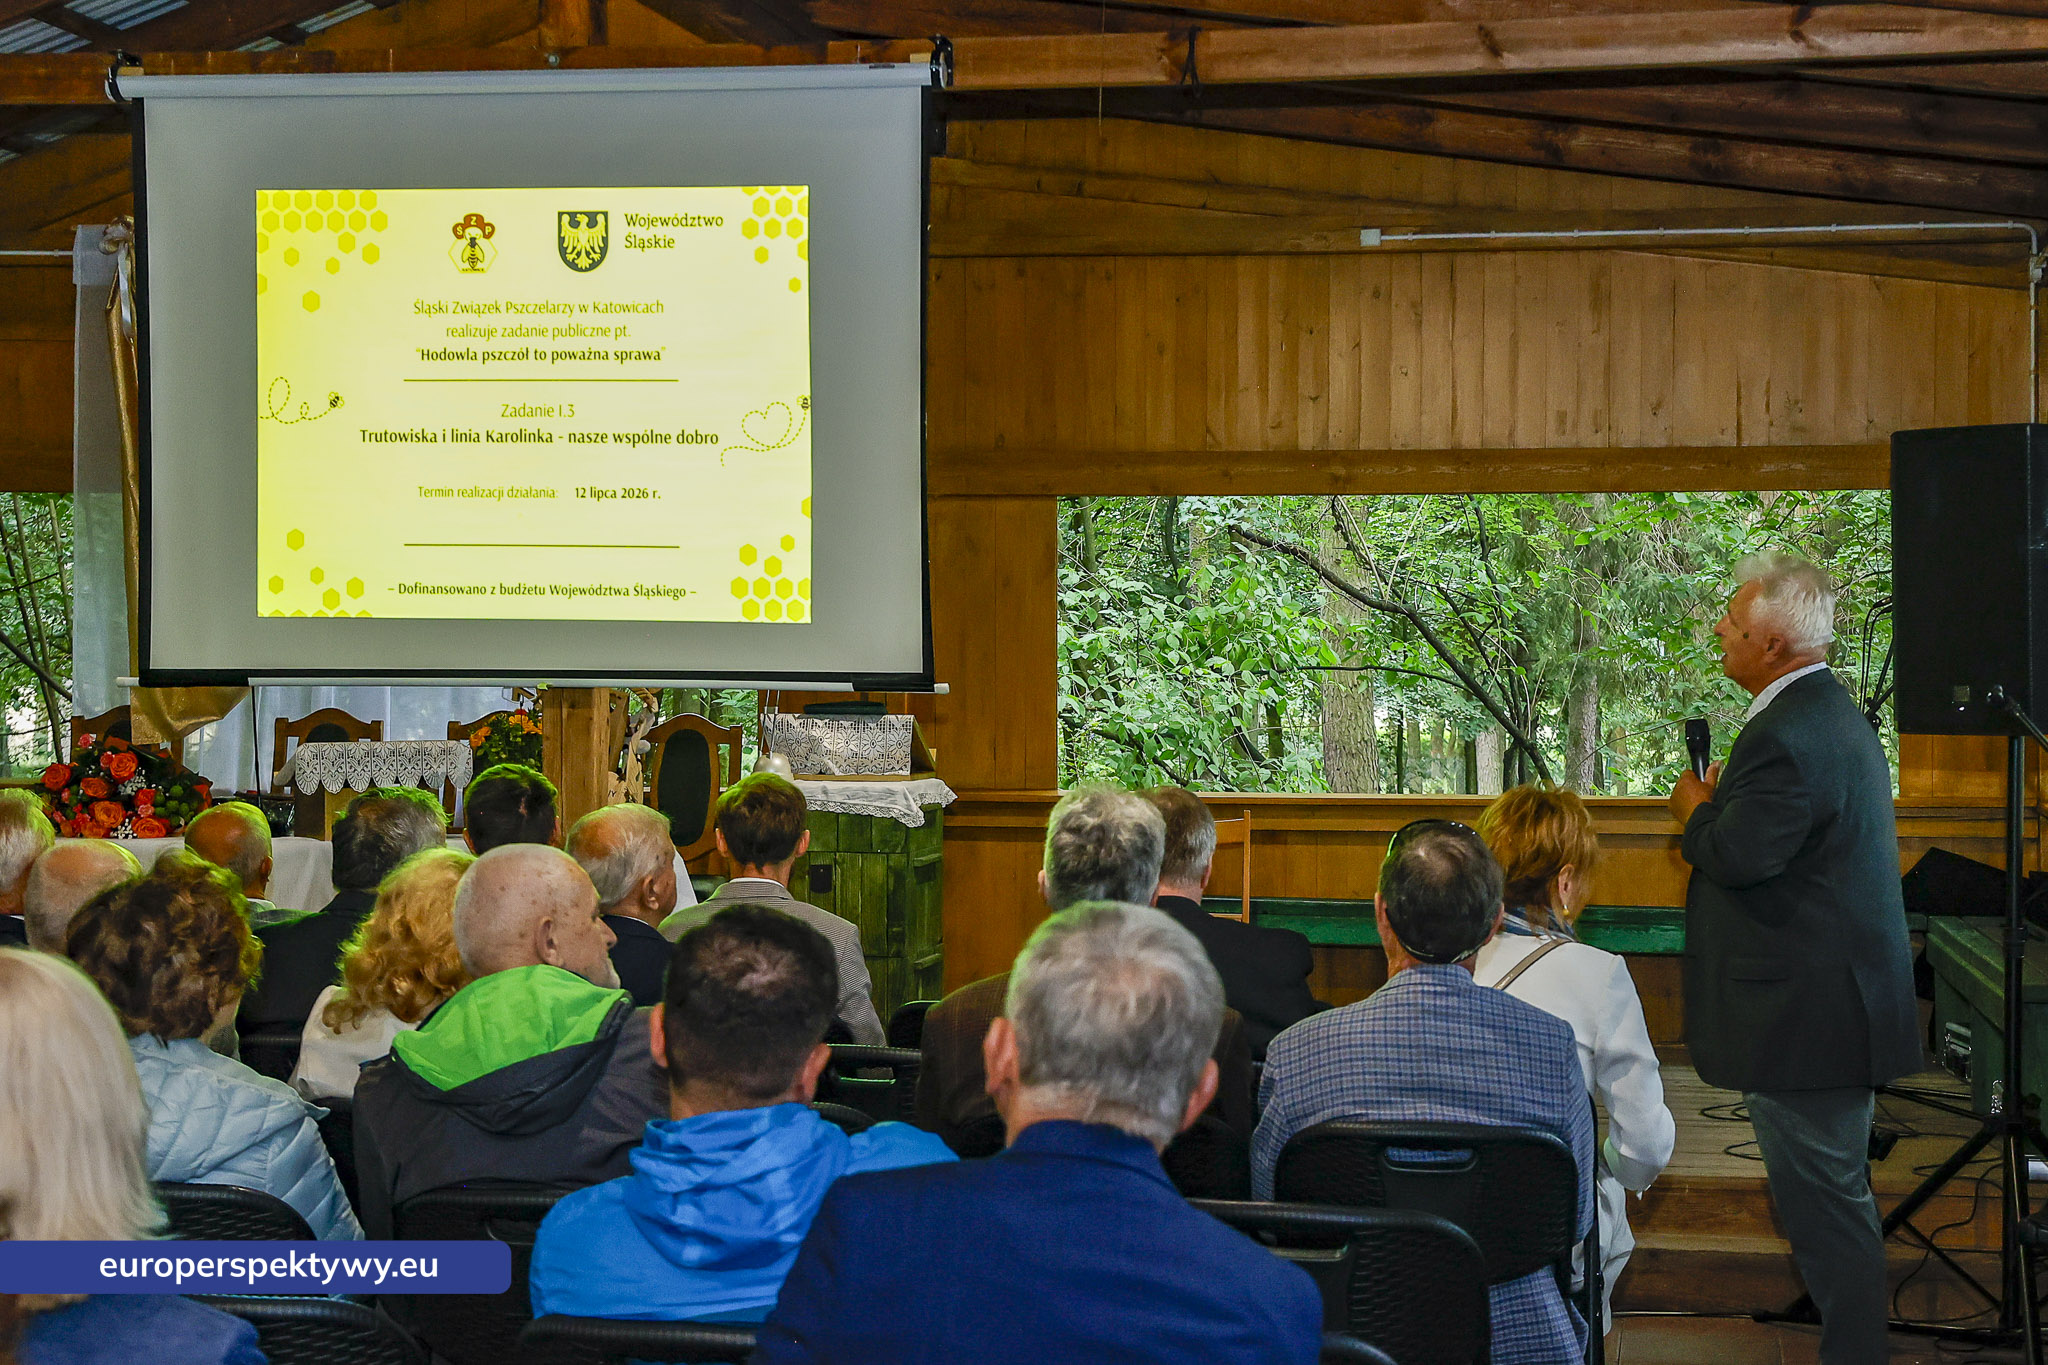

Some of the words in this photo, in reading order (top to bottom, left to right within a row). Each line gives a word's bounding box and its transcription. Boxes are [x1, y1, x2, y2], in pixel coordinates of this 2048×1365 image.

[623, 212, 725, 231] Województwo
[623, 231, 676, 253] Śląskie
[413, 298, 449, 319] Śląski
[451, 299, 502, 319] Związek
[505, 299, 575, 318] Pszczelarzy
[577, 303, 590, 314] w
[592, 299, 664, 315] Katowicach
[445, 322, 498, 342] realizuje
[500, 322, 549, 338] zadanie
[551, 323, 612, 342] publiczne
[614, 324, 632, 342] pt.
[481, 346, 530, 366] pszczół
[533, 347, 548, 362] to
[550, 346, 610, 366] poważna
[500, 401, 555, 418] Zadanie
[359, 427, 439, 444] Trutowiska
[441, 427, 448, 444] i
[450, 427, 481, 444] linia
[485, 427, 554, 445] Karolinka
[567, 432, 609, 446] nasze
[611, 428, 672, 450] wspólne
[675, 428, 720, 446] dobro
[417, 485, 455, 499] Termin
[456, 484, 505, 502] realizacji
[506, 485, 560, 499] działania:
[574, 486, 587, 499] 12
[589, 485, 618, 503] lipca
[620, 487, 650, 500] 2026
[652, 489, 662, 500] r.
[397, 581, 487, 597] Dofinansowano
[489, 585, 497, 596] z
[499, 580, 546, 597] budżetu
[548, 582, 631, 601] Województwa
[633, 581, 687, 603] Śląskiego
